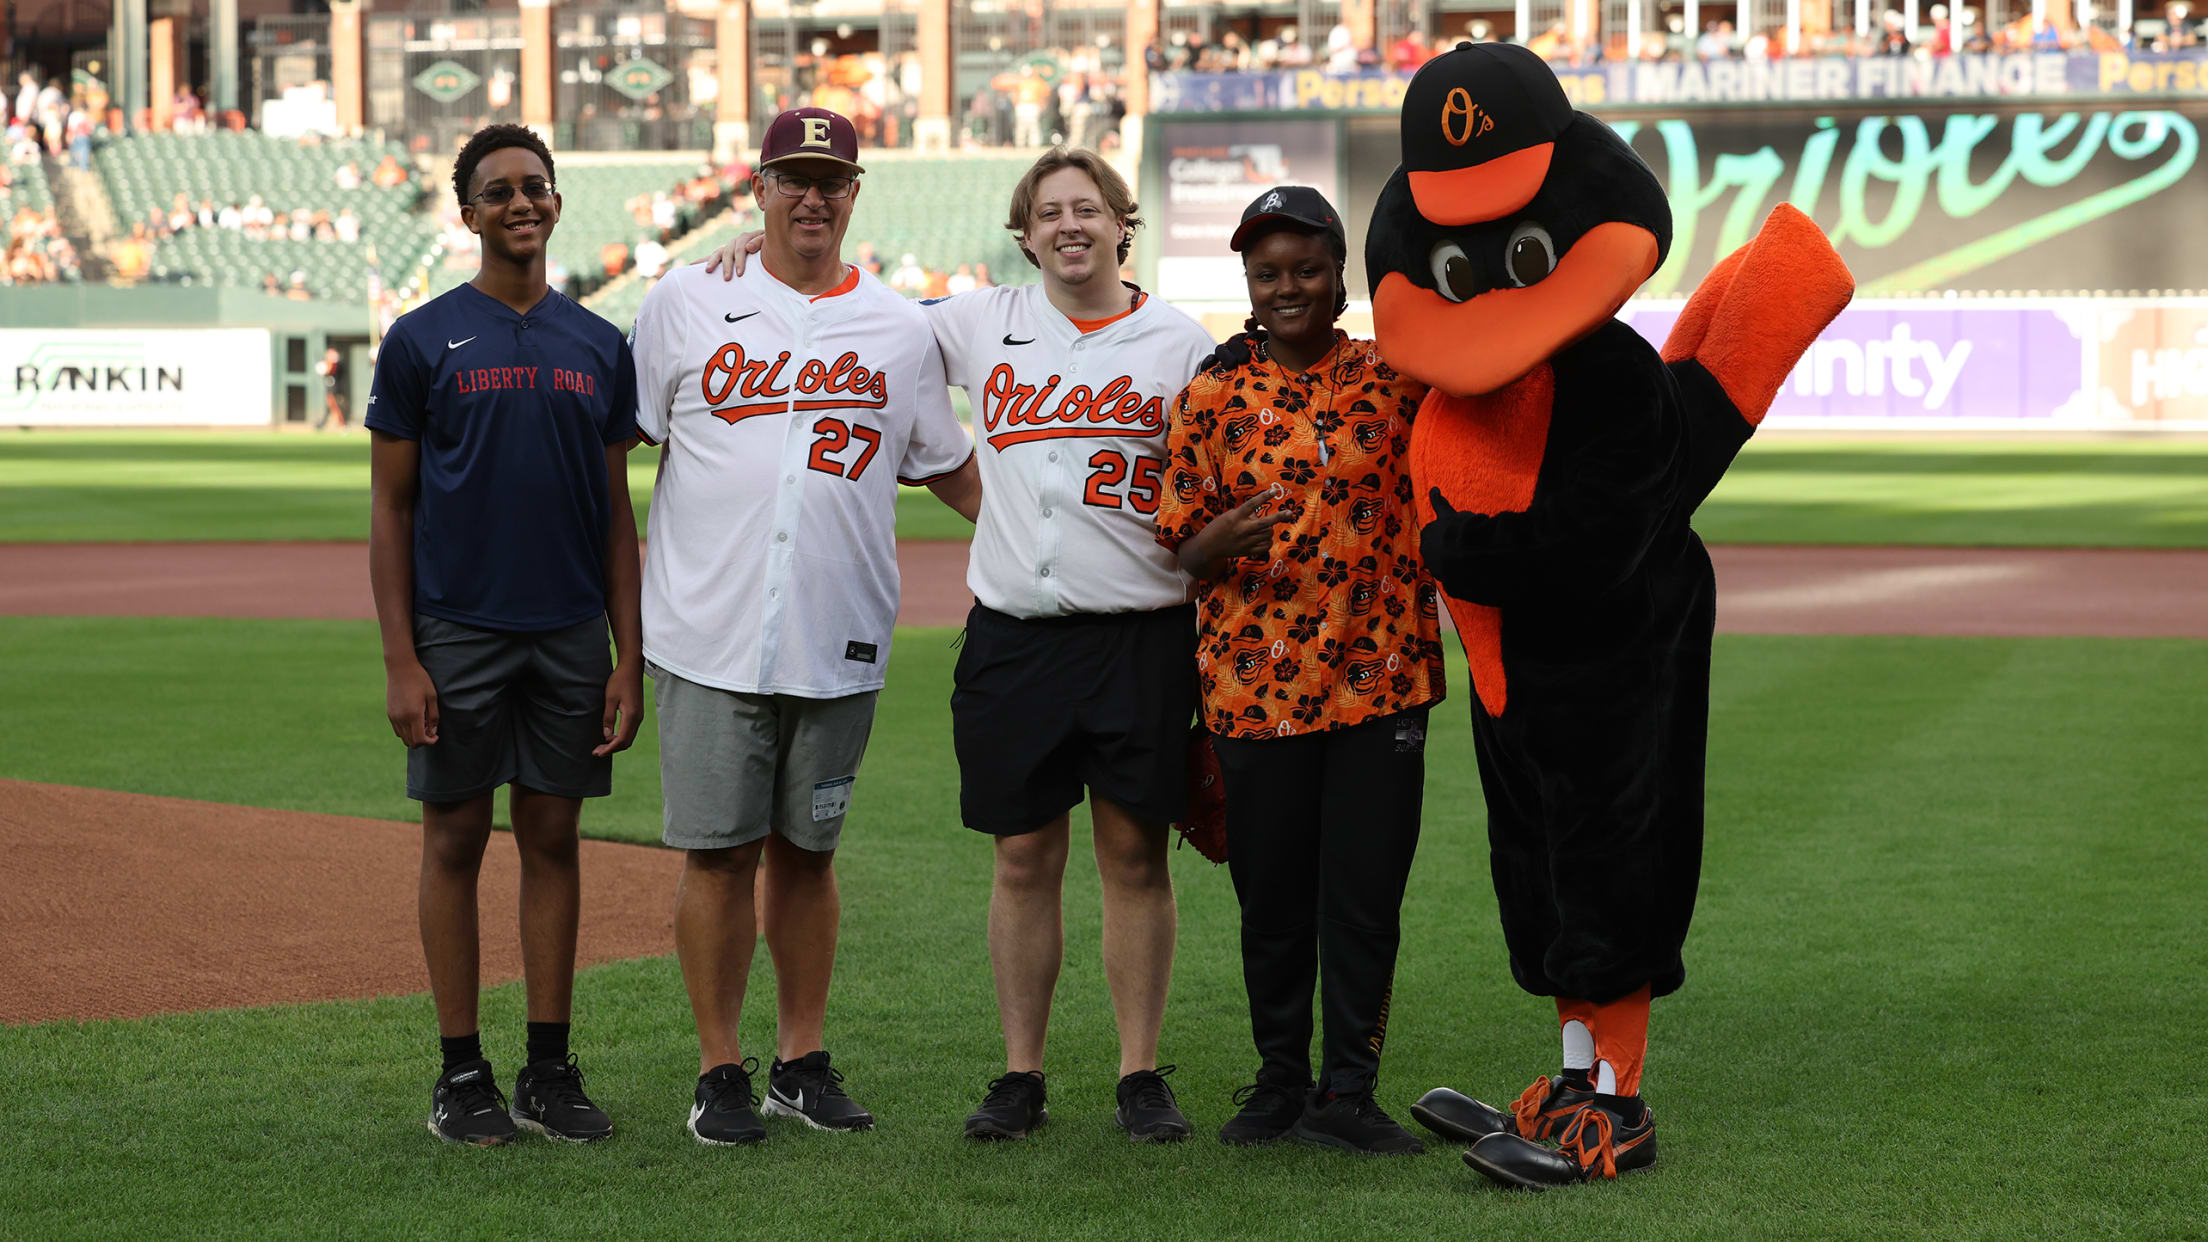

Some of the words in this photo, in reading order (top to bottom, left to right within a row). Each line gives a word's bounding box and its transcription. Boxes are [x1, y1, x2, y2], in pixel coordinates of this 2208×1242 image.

[1636, 60, 1849, 101] MARINER
[1858, 52, 2066, 97] FINANCE
[800, 117, 832, 149] E
[1441, 87, 1495, 147] O's
[15, 366, 183, 392] RANKIN
[455, 366, 539, 394] LIBERTY
[553, 368, 595, 397] ROAD
[701, 341, 889, 407] Orioles
[983, 362, 1165, 434] Orioles
[807, 416, 882, 482] 27
[1082, 449, 1163, 515] 25
